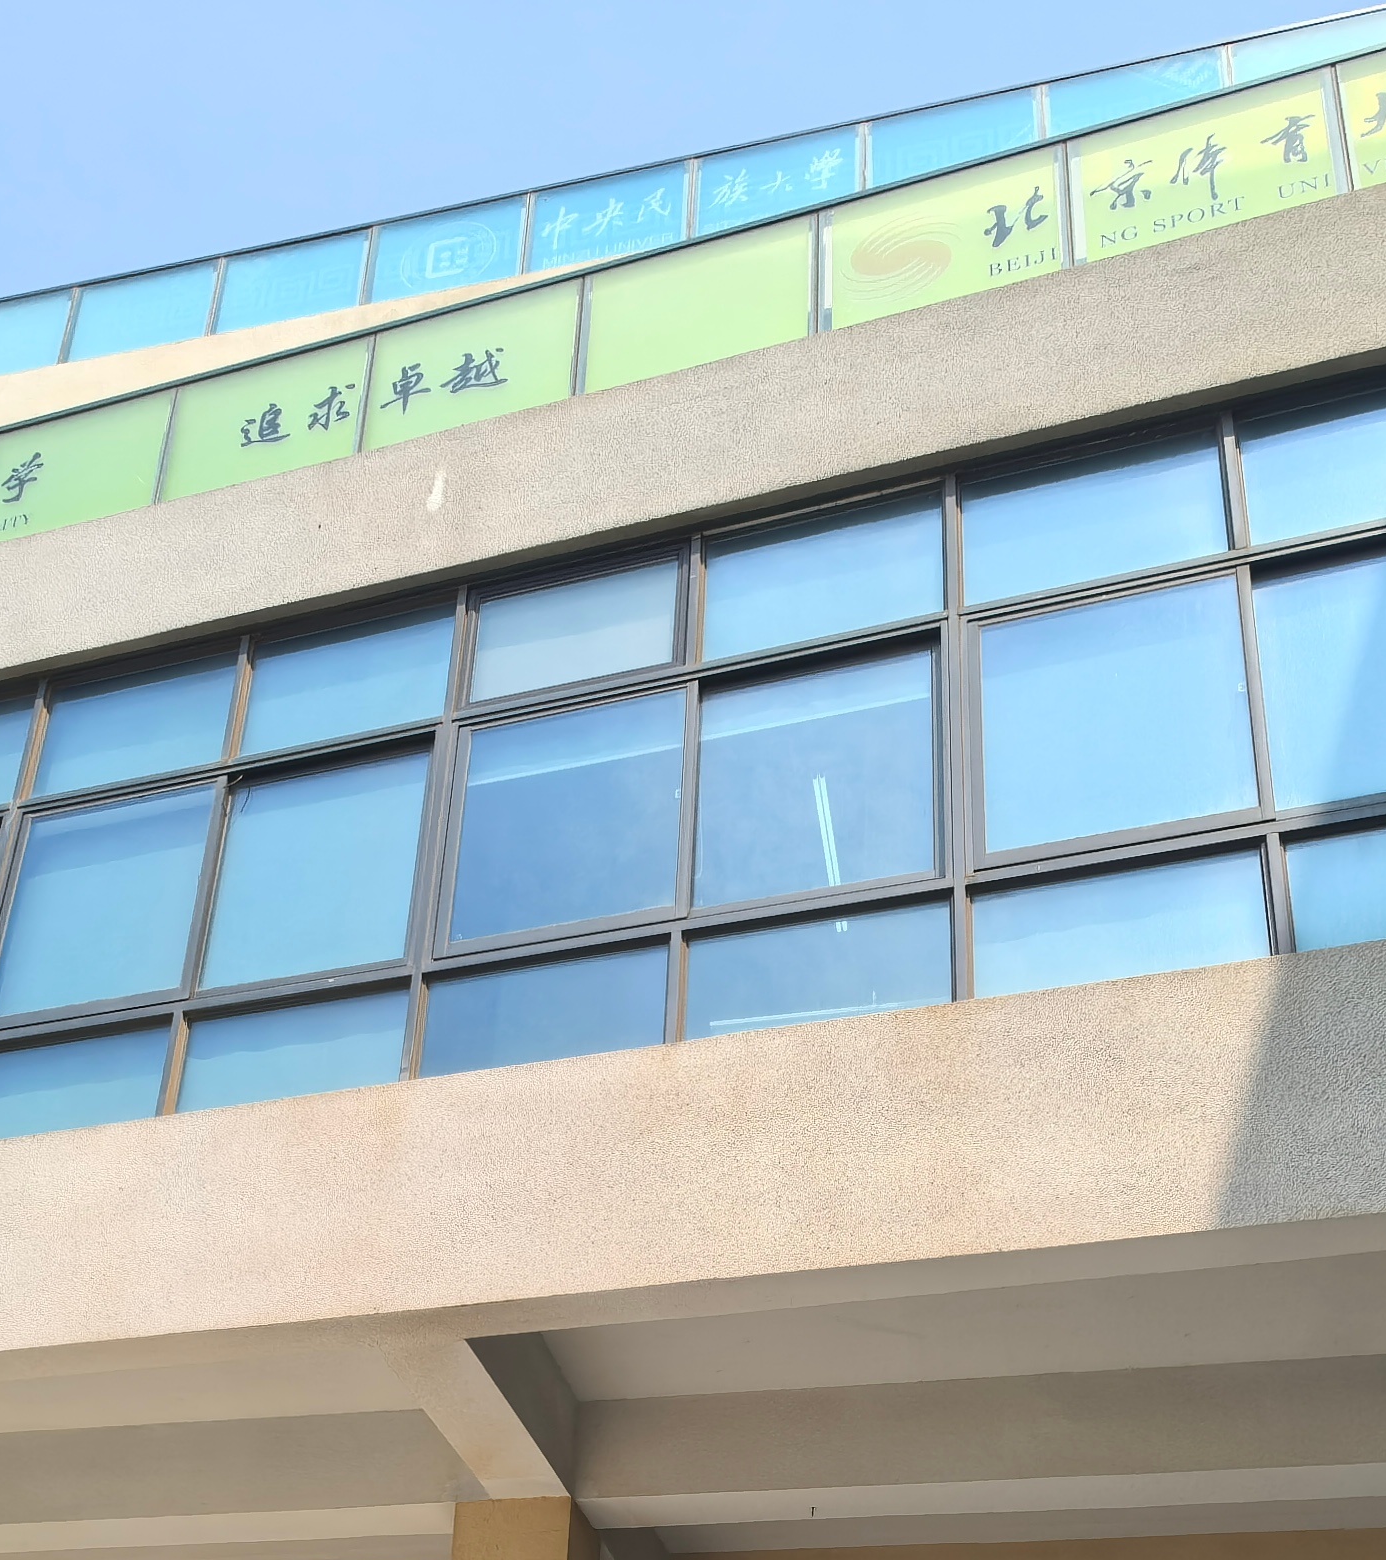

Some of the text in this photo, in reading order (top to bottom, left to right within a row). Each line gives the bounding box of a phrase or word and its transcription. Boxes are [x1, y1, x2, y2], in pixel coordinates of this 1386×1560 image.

[1152, 196, 1245, 234] SPORT
[240, 347, 508, 447] 追求卓越
